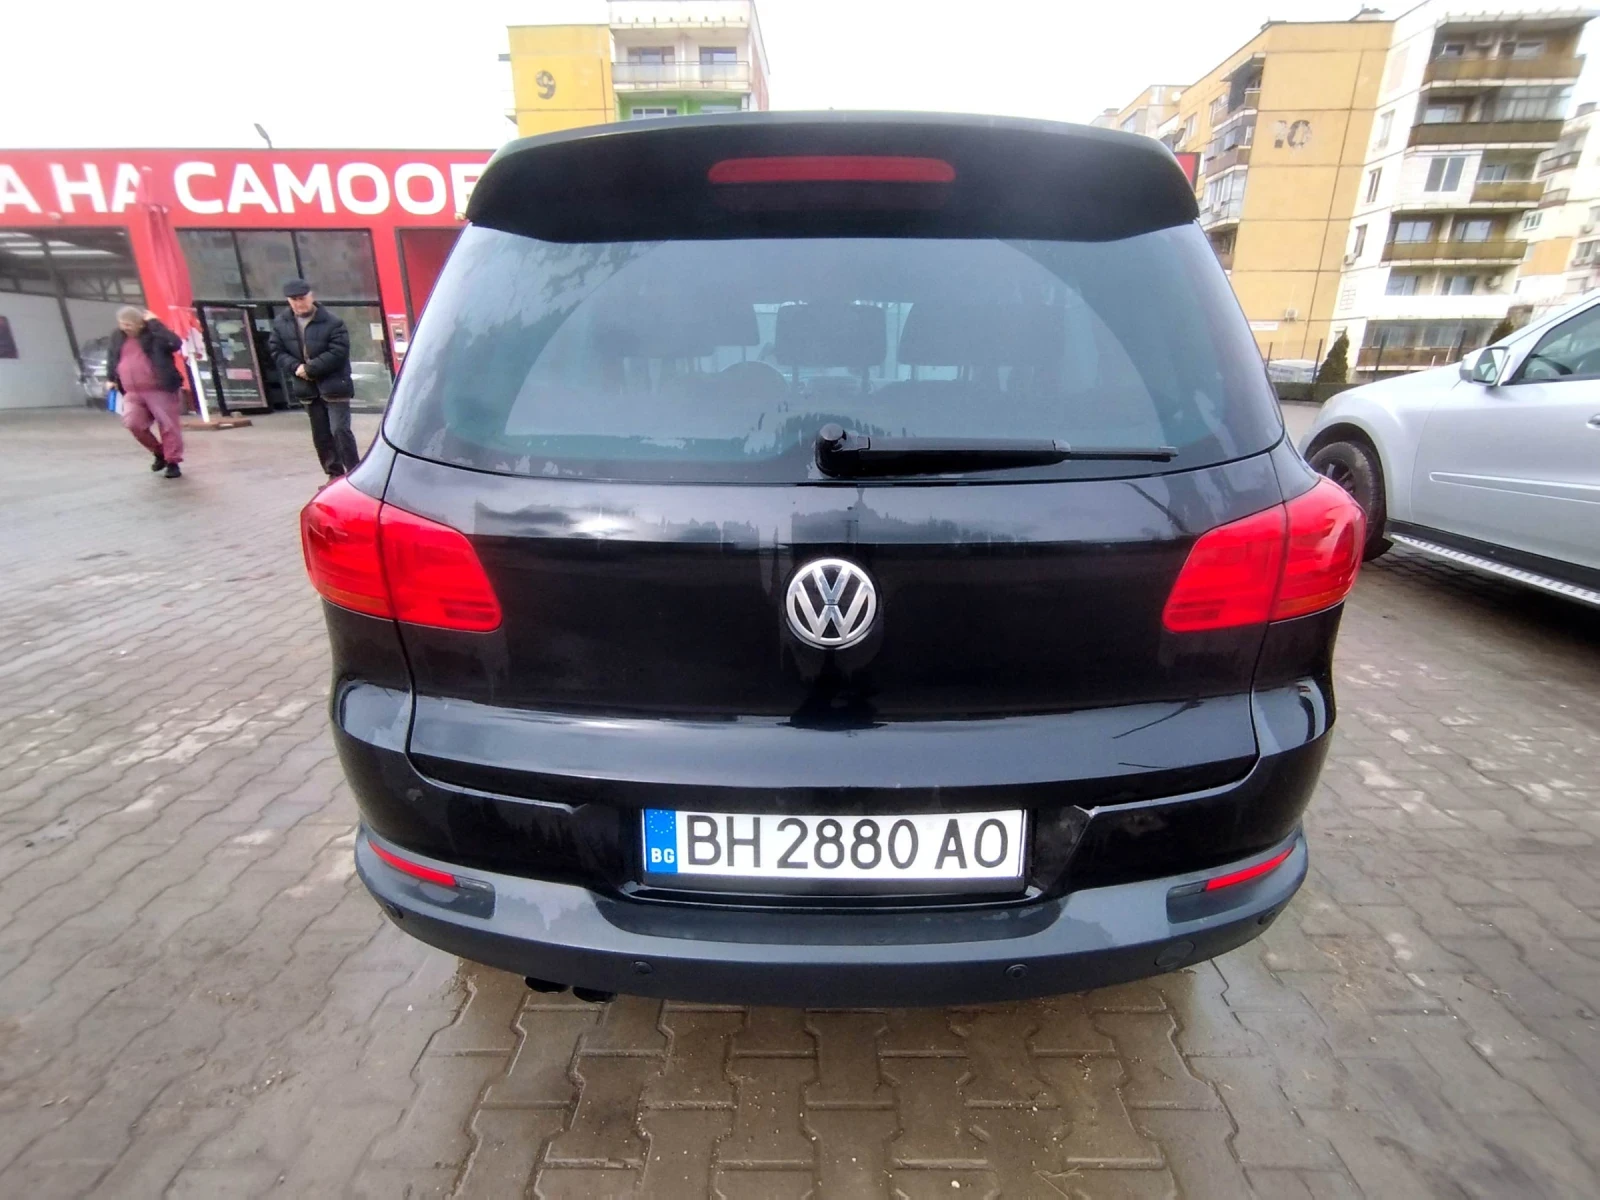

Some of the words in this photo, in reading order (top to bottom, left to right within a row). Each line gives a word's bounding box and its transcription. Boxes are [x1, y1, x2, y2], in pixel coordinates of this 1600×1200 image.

[535, 69, 556, 100] 9
[651, 847, 675, 864] BG
[686, 814, 761, 868] BH
[776, 818, 919, 870] 2880
[934, 817, 1009, 870] AO
